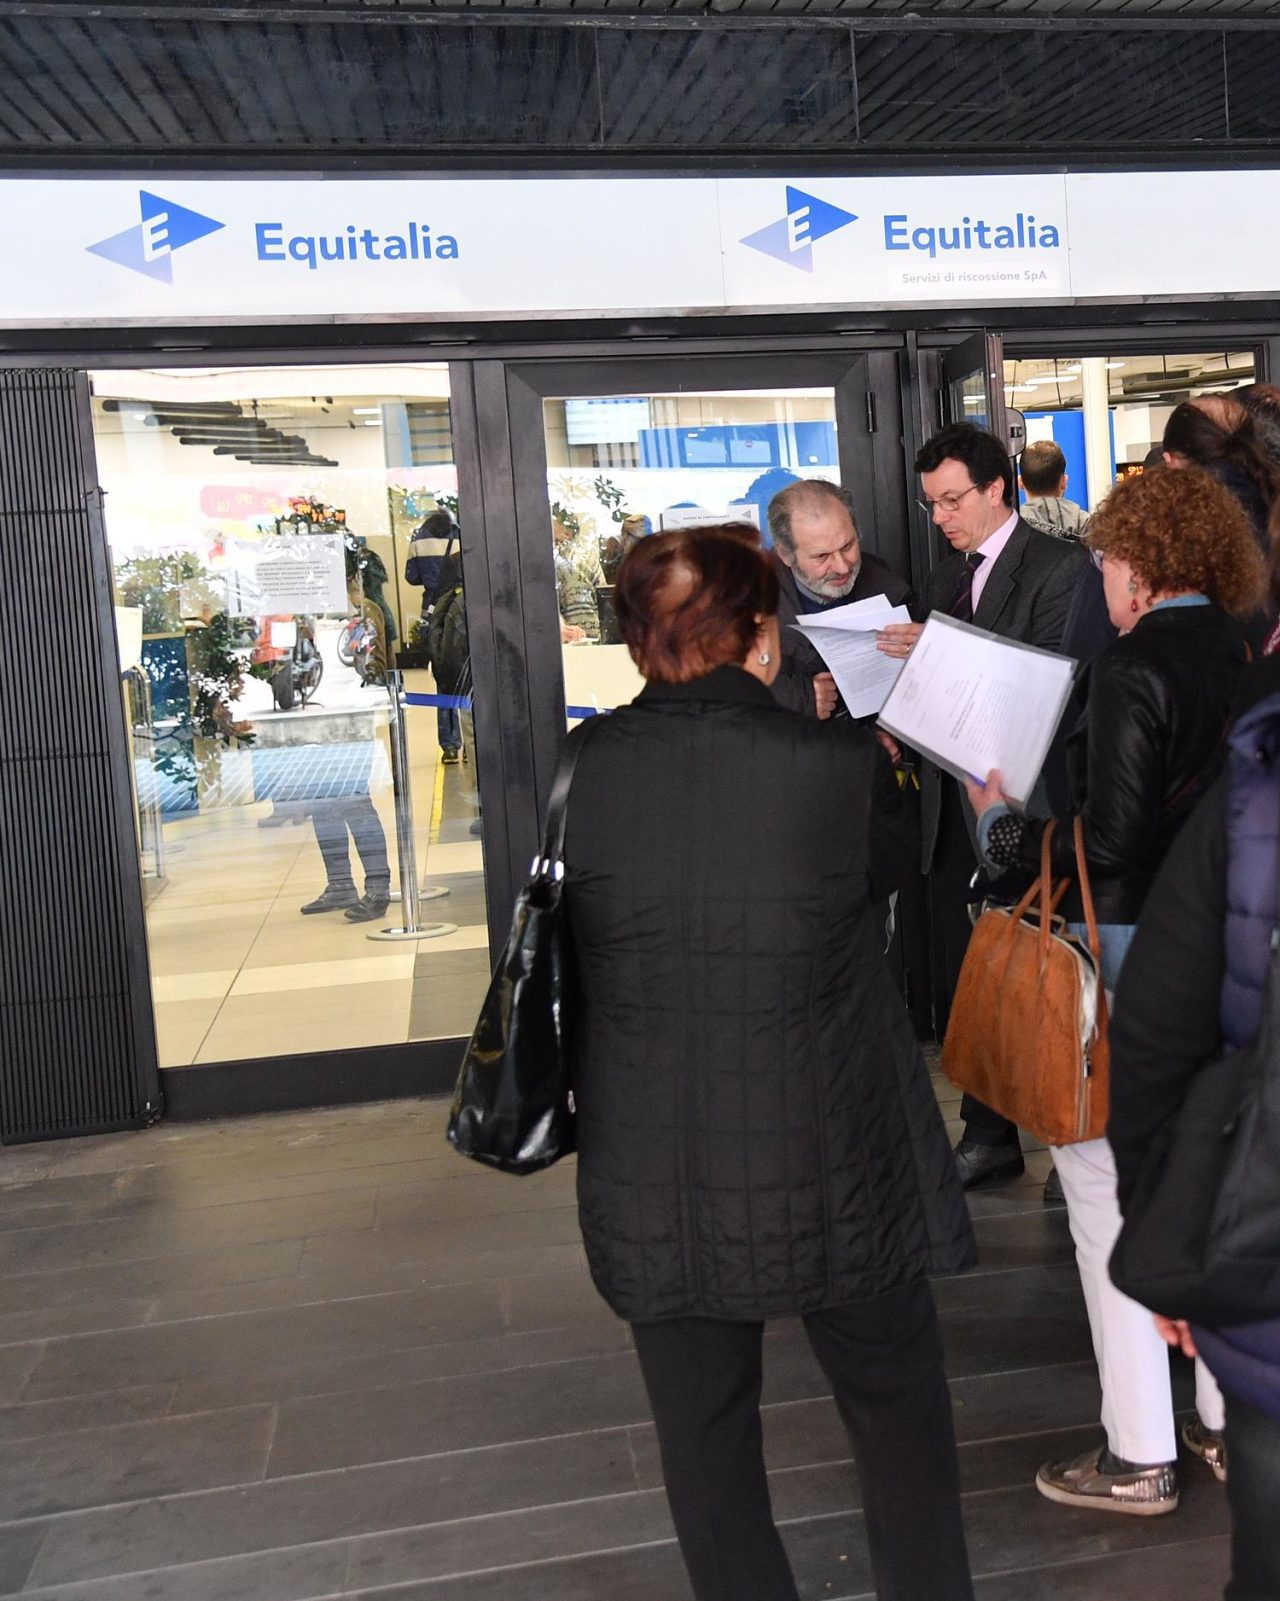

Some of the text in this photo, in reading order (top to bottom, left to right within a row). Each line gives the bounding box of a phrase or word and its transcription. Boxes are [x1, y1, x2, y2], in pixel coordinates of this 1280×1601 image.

[255, 221, 459, 269] Equitalia
[883, 212, 1060, 258] Equitalia
[902, 269, 1047, 284] Servizi di riscossione SpA
